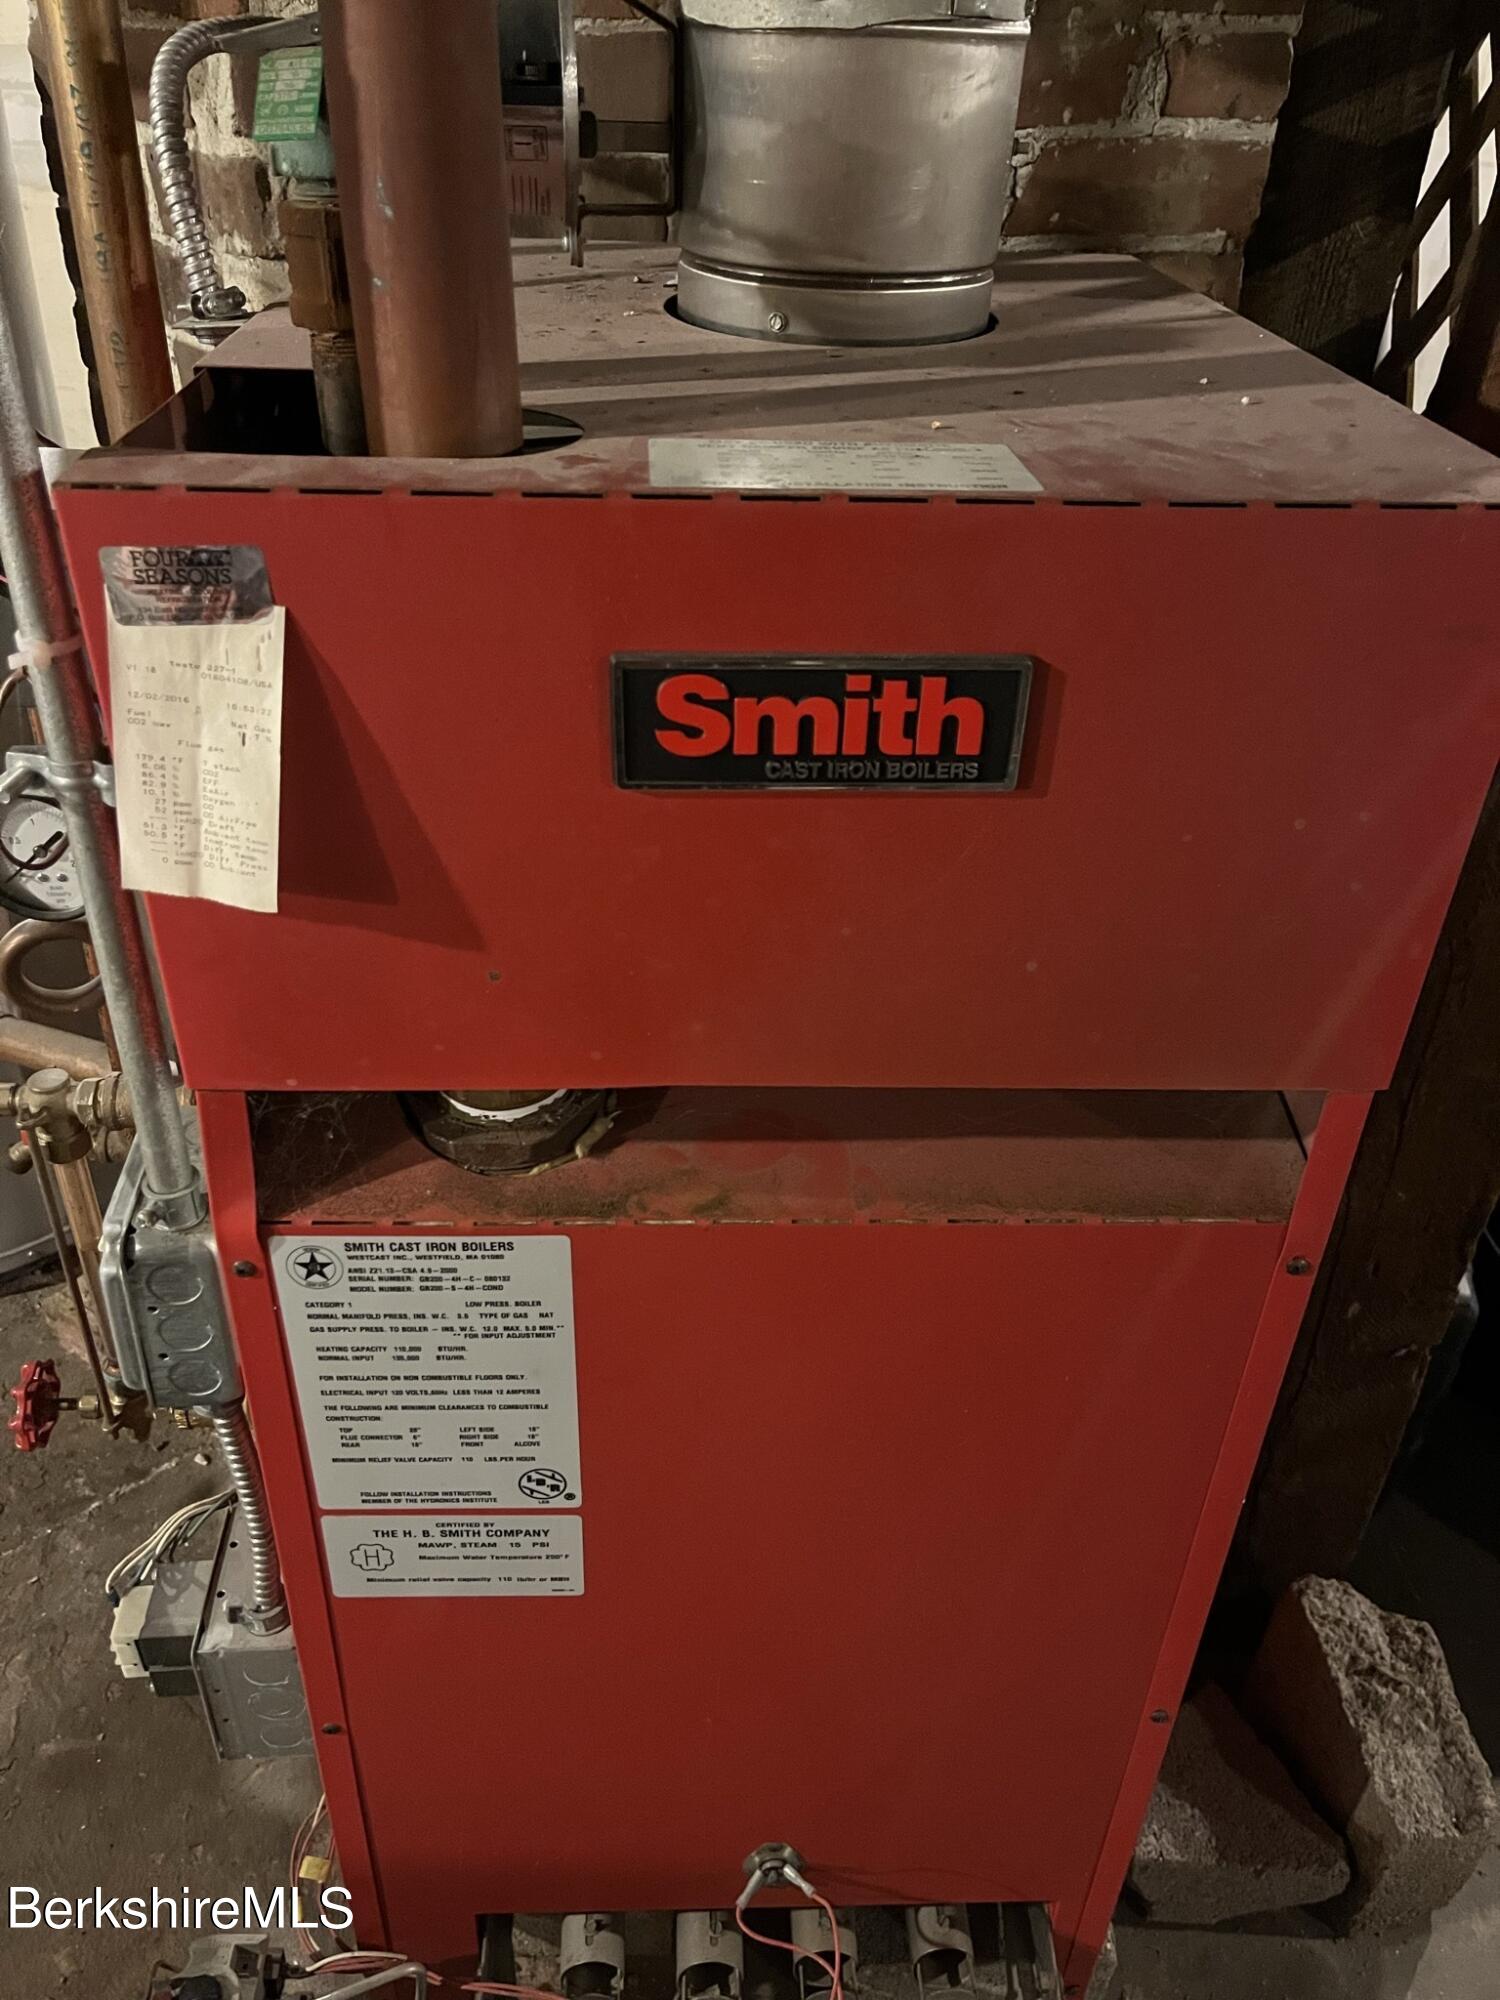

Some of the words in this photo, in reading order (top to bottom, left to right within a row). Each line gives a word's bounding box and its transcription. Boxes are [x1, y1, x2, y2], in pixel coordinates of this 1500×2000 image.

[128, 550, 191, 567] FOUR
[132, 569, 232, 585] SEASONS
[655, 674, 984, 757] Smith
[764, 760, 822, 780] CAST
[826, 760, 880, 780] IRON
[886, 760, 979, 780] BOILERS
[344, 1242, 384, 1252] SMITH
[389, 1242, 421, 1252] CAST
[426, 1242, 456, 1252] IRON
[462, 1242, 514, 1251] BOILERS
[372, 1529, 398, 1538] THE
[422, 1529, 435, 1538] B.
[440, 1529, 481, 1538] SMITH
[486, 1529, 550, 1537] COMPANY
